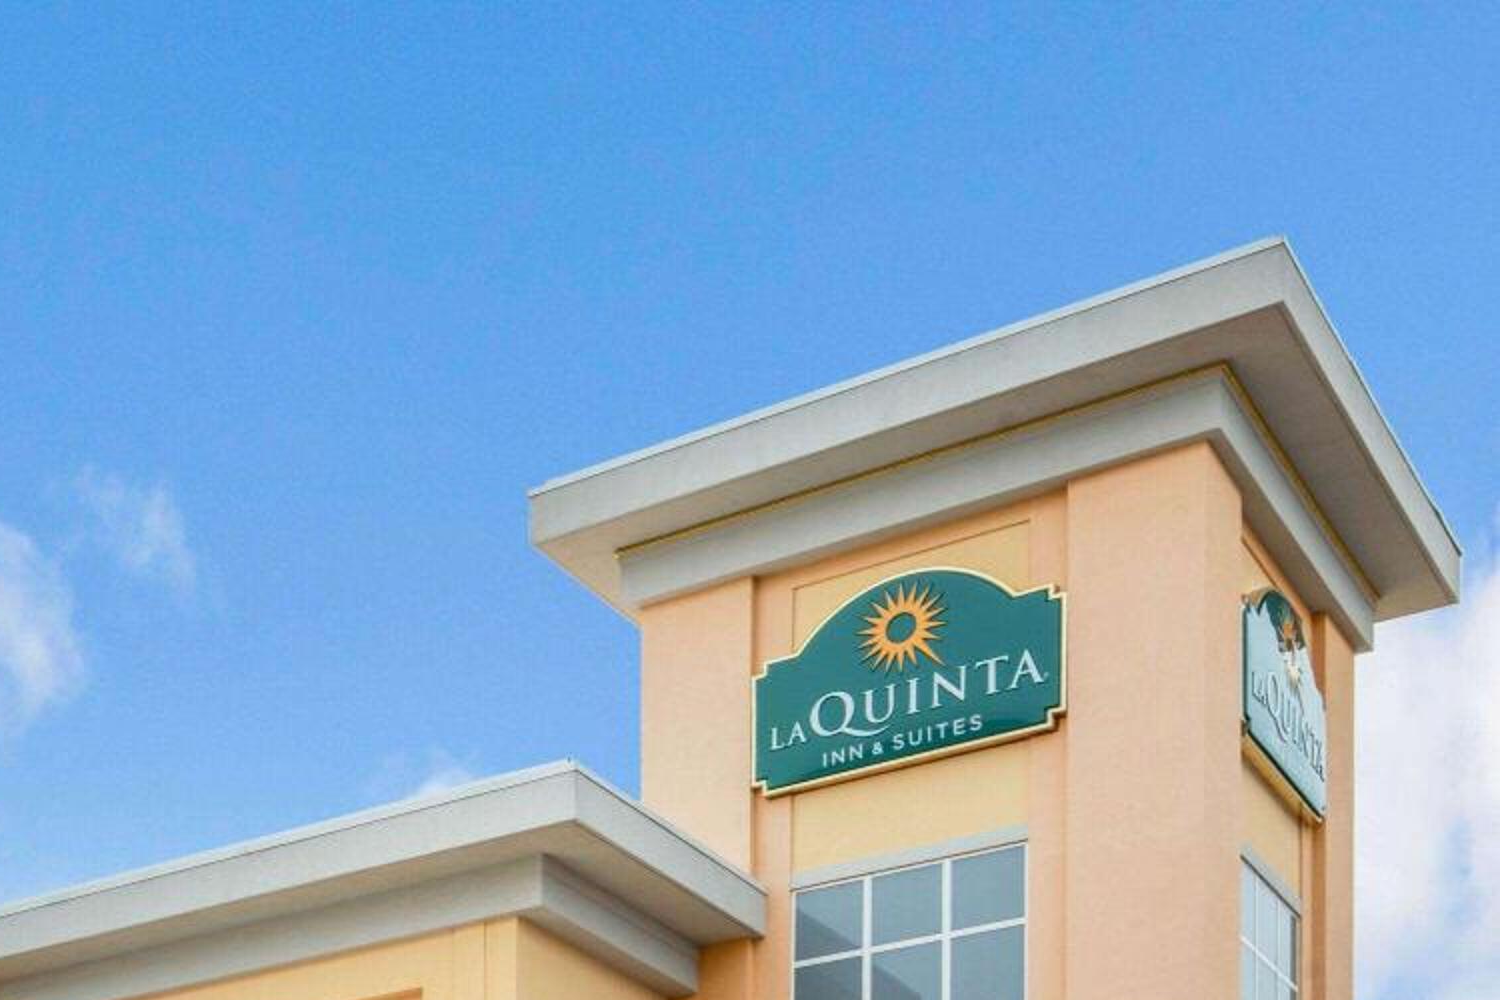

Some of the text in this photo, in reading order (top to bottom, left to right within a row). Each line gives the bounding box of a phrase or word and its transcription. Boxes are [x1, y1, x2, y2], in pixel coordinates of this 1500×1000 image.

[770, 650, 1044, 750] LA QUINTA
[822, 714, 983, 768] INN & SUITES
